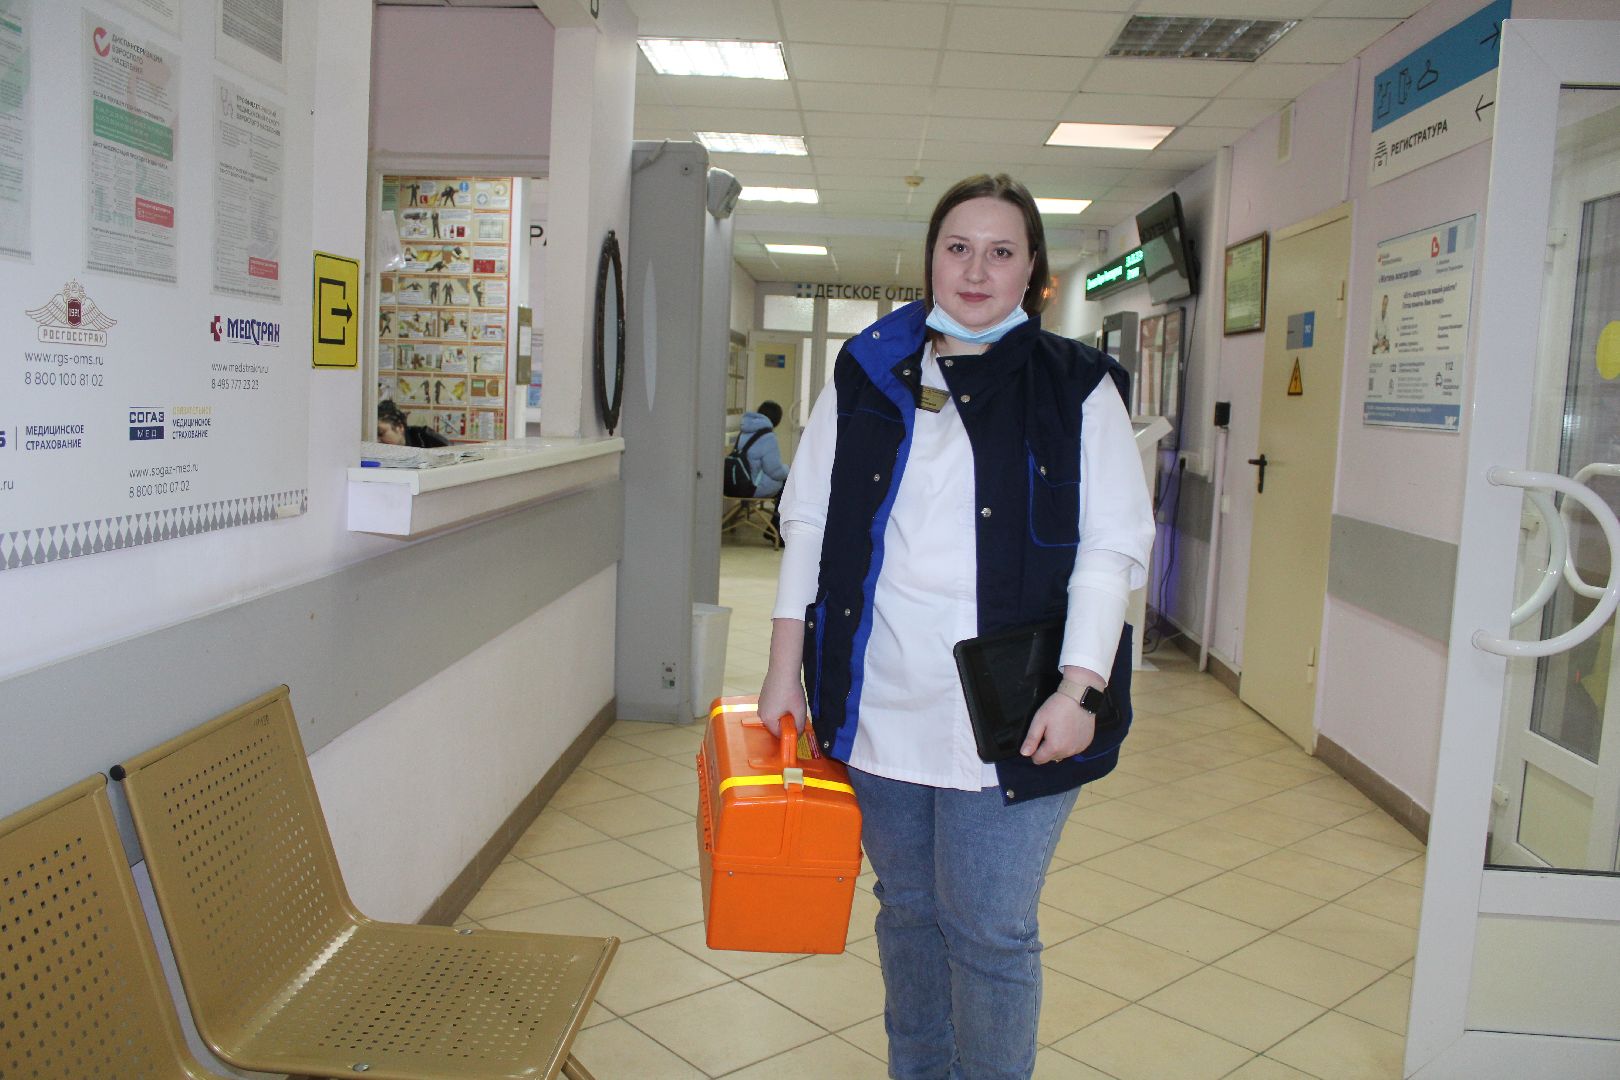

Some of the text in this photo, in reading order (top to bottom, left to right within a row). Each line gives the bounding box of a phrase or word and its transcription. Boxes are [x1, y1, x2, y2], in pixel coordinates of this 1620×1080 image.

[1390, 119, 1448, 157] РЕГИСТРАТУРА
[815, 284, 881, 300] ДЕТСКОЕ
[43, 329, 104, 344] РОСГОССТРАХ
[227, 317, 280, 346] МЕДСТРАХ
[25, 352, 104, 366] www.rgs-oms.ru
[24, 371, 104, 387] 8 800 100 81 02
[211, 378, 216, 390] 8
[217, 378, 229, 390] 495
[231, 379, 242, 390] 777
[243, 379, 251, 390] 23
[129, 411, 165, 424] СОГАЗ
[172, 418, 211, 428] МЕДИЦИНСКОЕ
[25, 424, 84, 437] МЕДИЦИНСКОЕ
[137, 429, 157, 438] МЕД
[172, 429, 208, 440] СТРАХОВАНИЕ
[25, 438, 82, 451] СТРАХОВАНИЕ
[129, 463, 199, 478] www.sogaz-med.ru
[129, 480, 190, 498] 8 800 100 07 02
